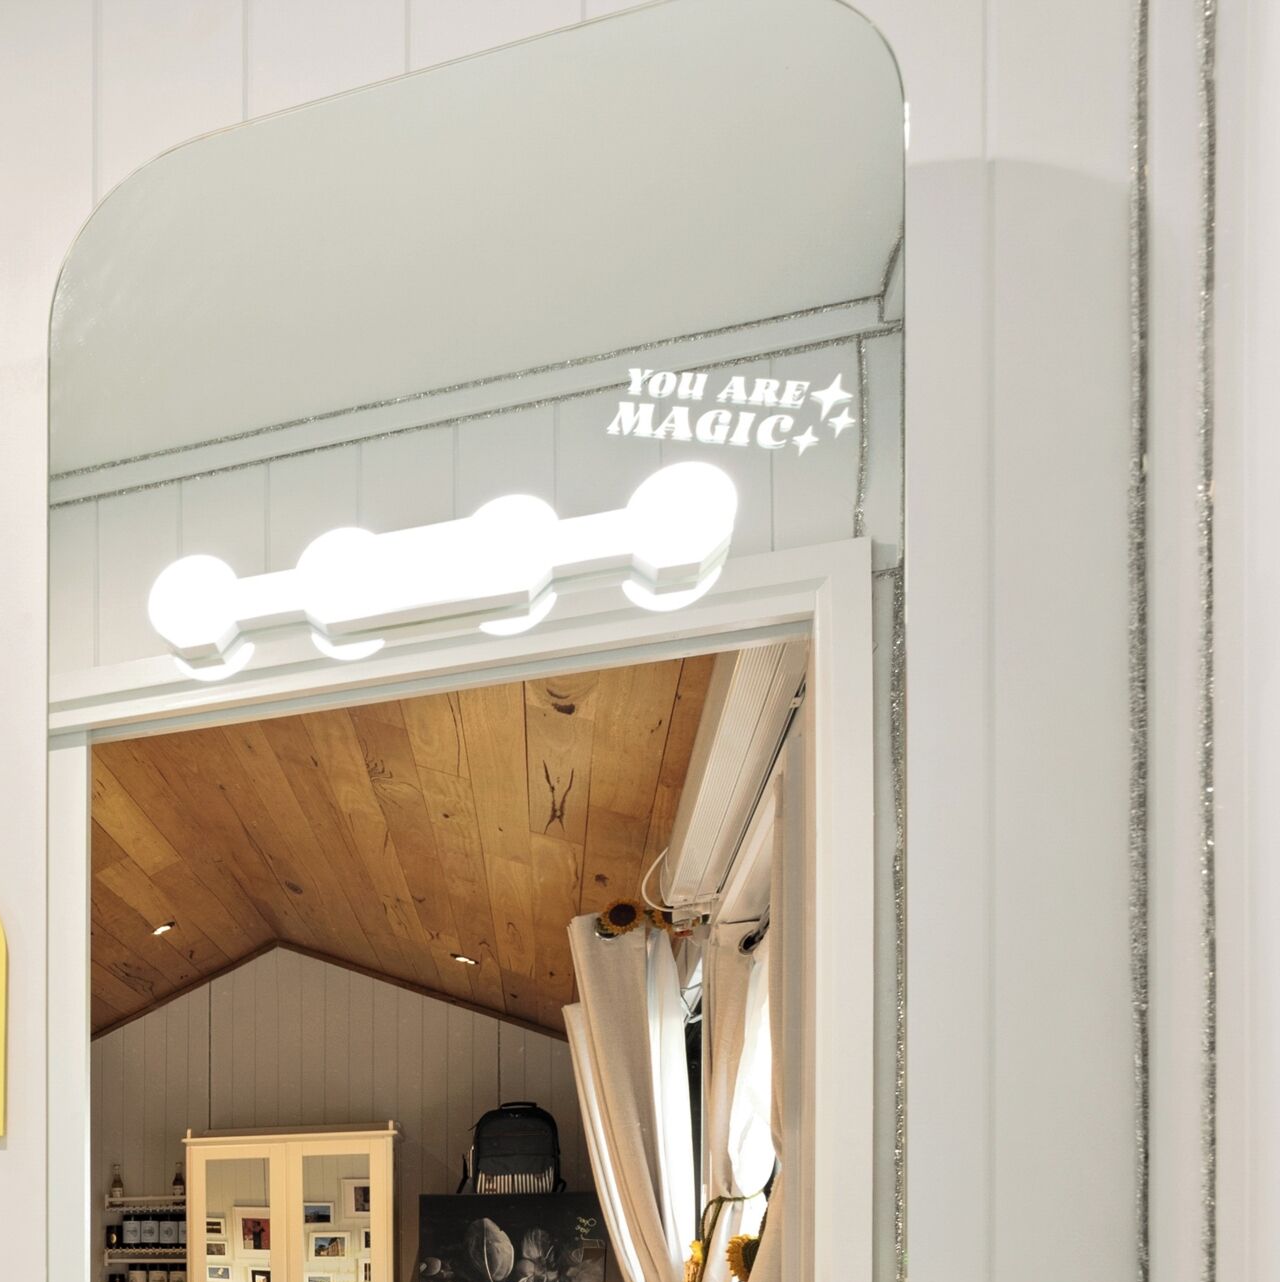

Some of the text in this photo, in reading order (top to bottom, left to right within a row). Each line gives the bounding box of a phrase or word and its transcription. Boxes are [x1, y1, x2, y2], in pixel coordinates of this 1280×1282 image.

[627, 368, 810, 409] YOU ARE
[607, 401, 794, 450] MAGIC
